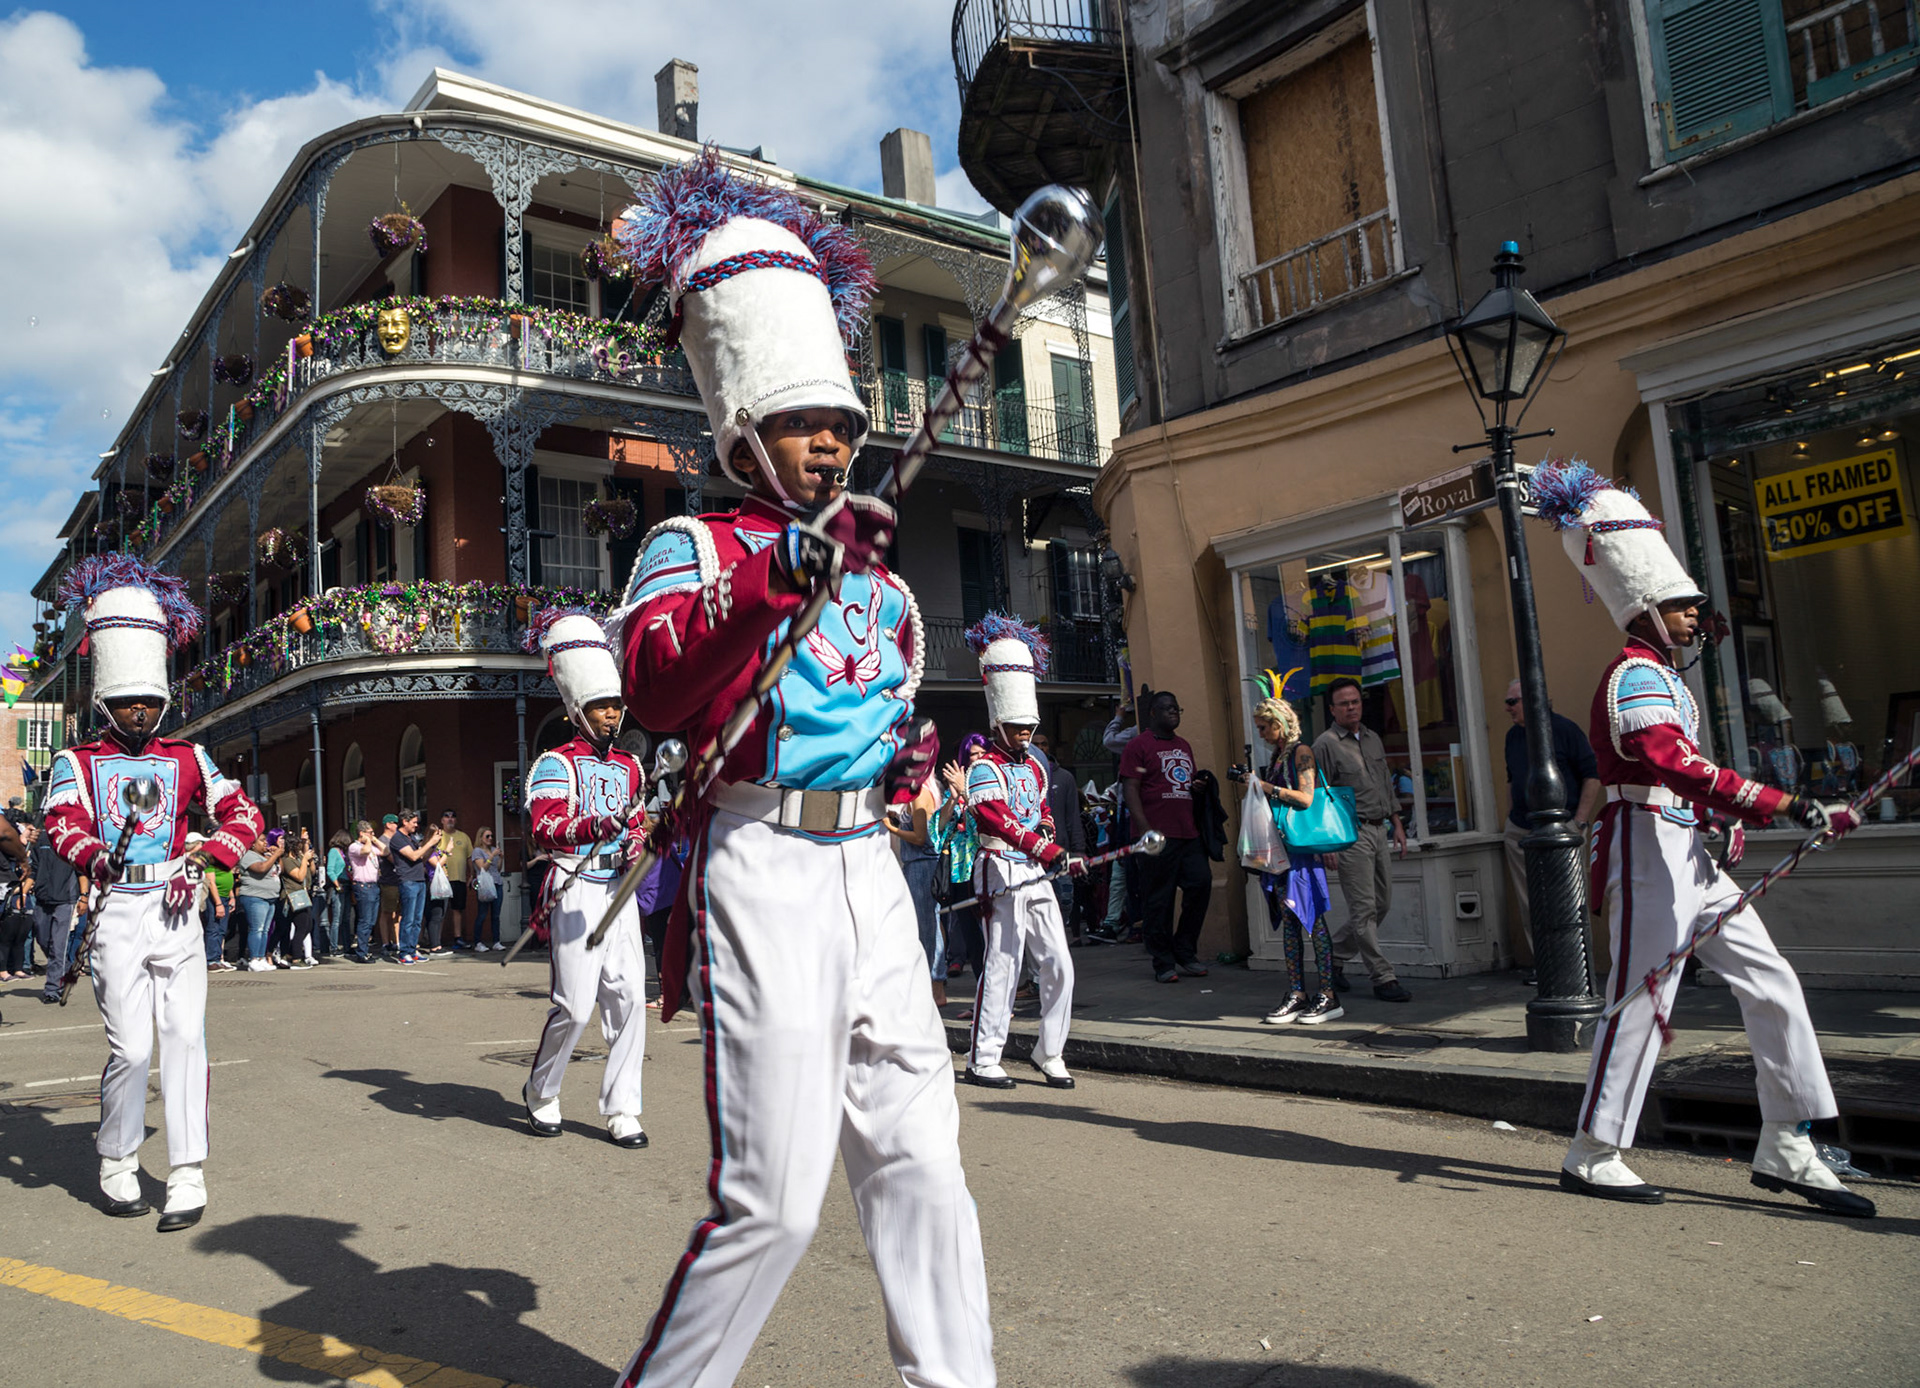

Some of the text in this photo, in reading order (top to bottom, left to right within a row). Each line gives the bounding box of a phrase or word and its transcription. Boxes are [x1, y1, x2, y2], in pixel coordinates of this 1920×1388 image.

[1420, 479, 1476, 516] Royal
[1765, 458, 1892, 508] ALL FRAMED
[1776, 496, 1892, 543] 50% OFF
